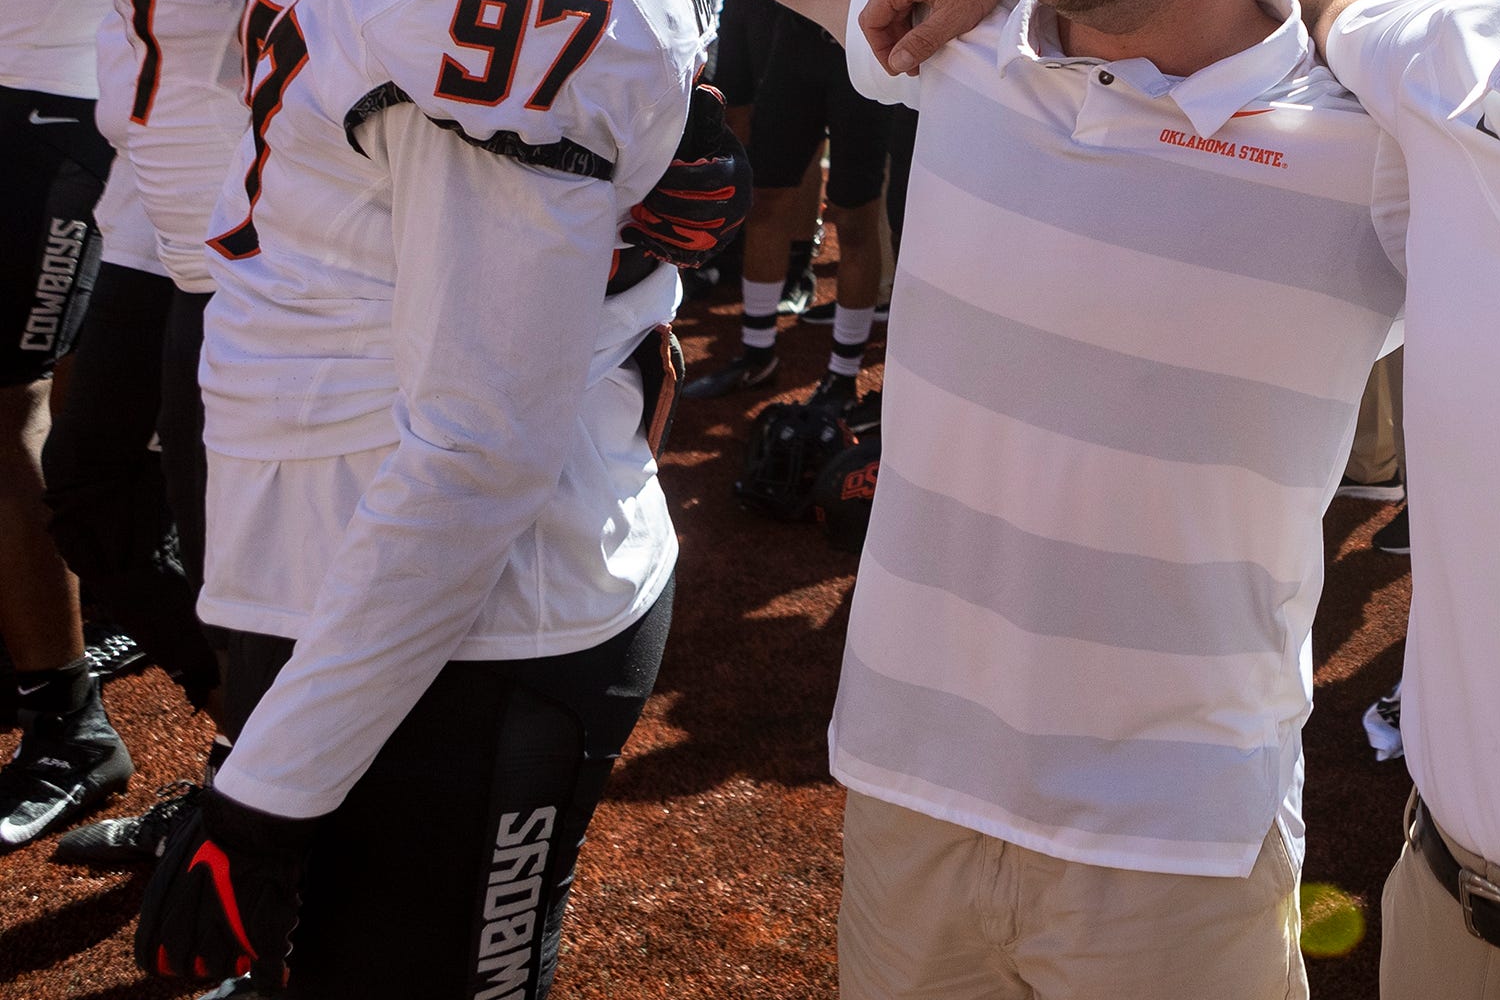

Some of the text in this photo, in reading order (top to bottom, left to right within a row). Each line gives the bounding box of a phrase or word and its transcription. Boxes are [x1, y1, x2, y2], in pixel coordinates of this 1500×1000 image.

[1159, 129, 1236, 158] OKLAHOMA
[19, 217, 88, 351] COWBOYS
[473, 805, 558, 1000] WBOYS
